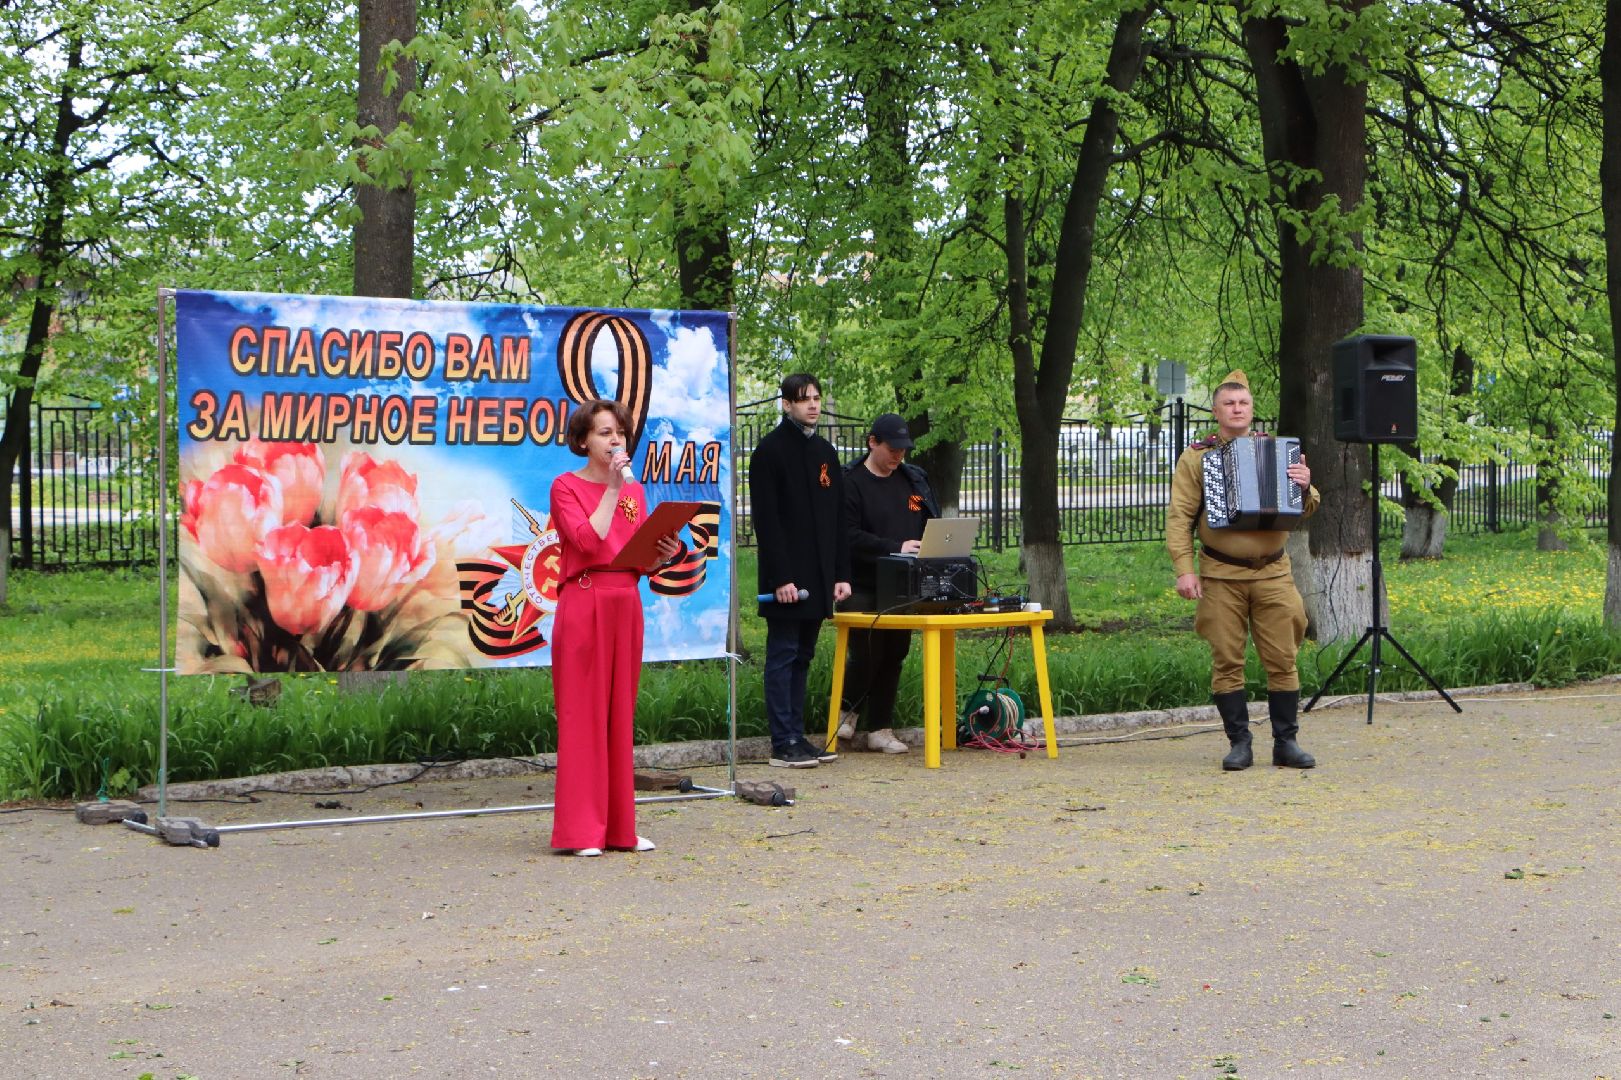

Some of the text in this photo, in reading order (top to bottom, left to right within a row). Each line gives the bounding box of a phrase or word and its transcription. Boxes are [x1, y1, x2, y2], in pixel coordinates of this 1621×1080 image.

[230, 325, 531, 383] СПАСИБО ВАМ
[186, 389, 569, 447] ЗА МИРНОЕ НЕБО!
[640, 441, 722, 484] МАЯ
